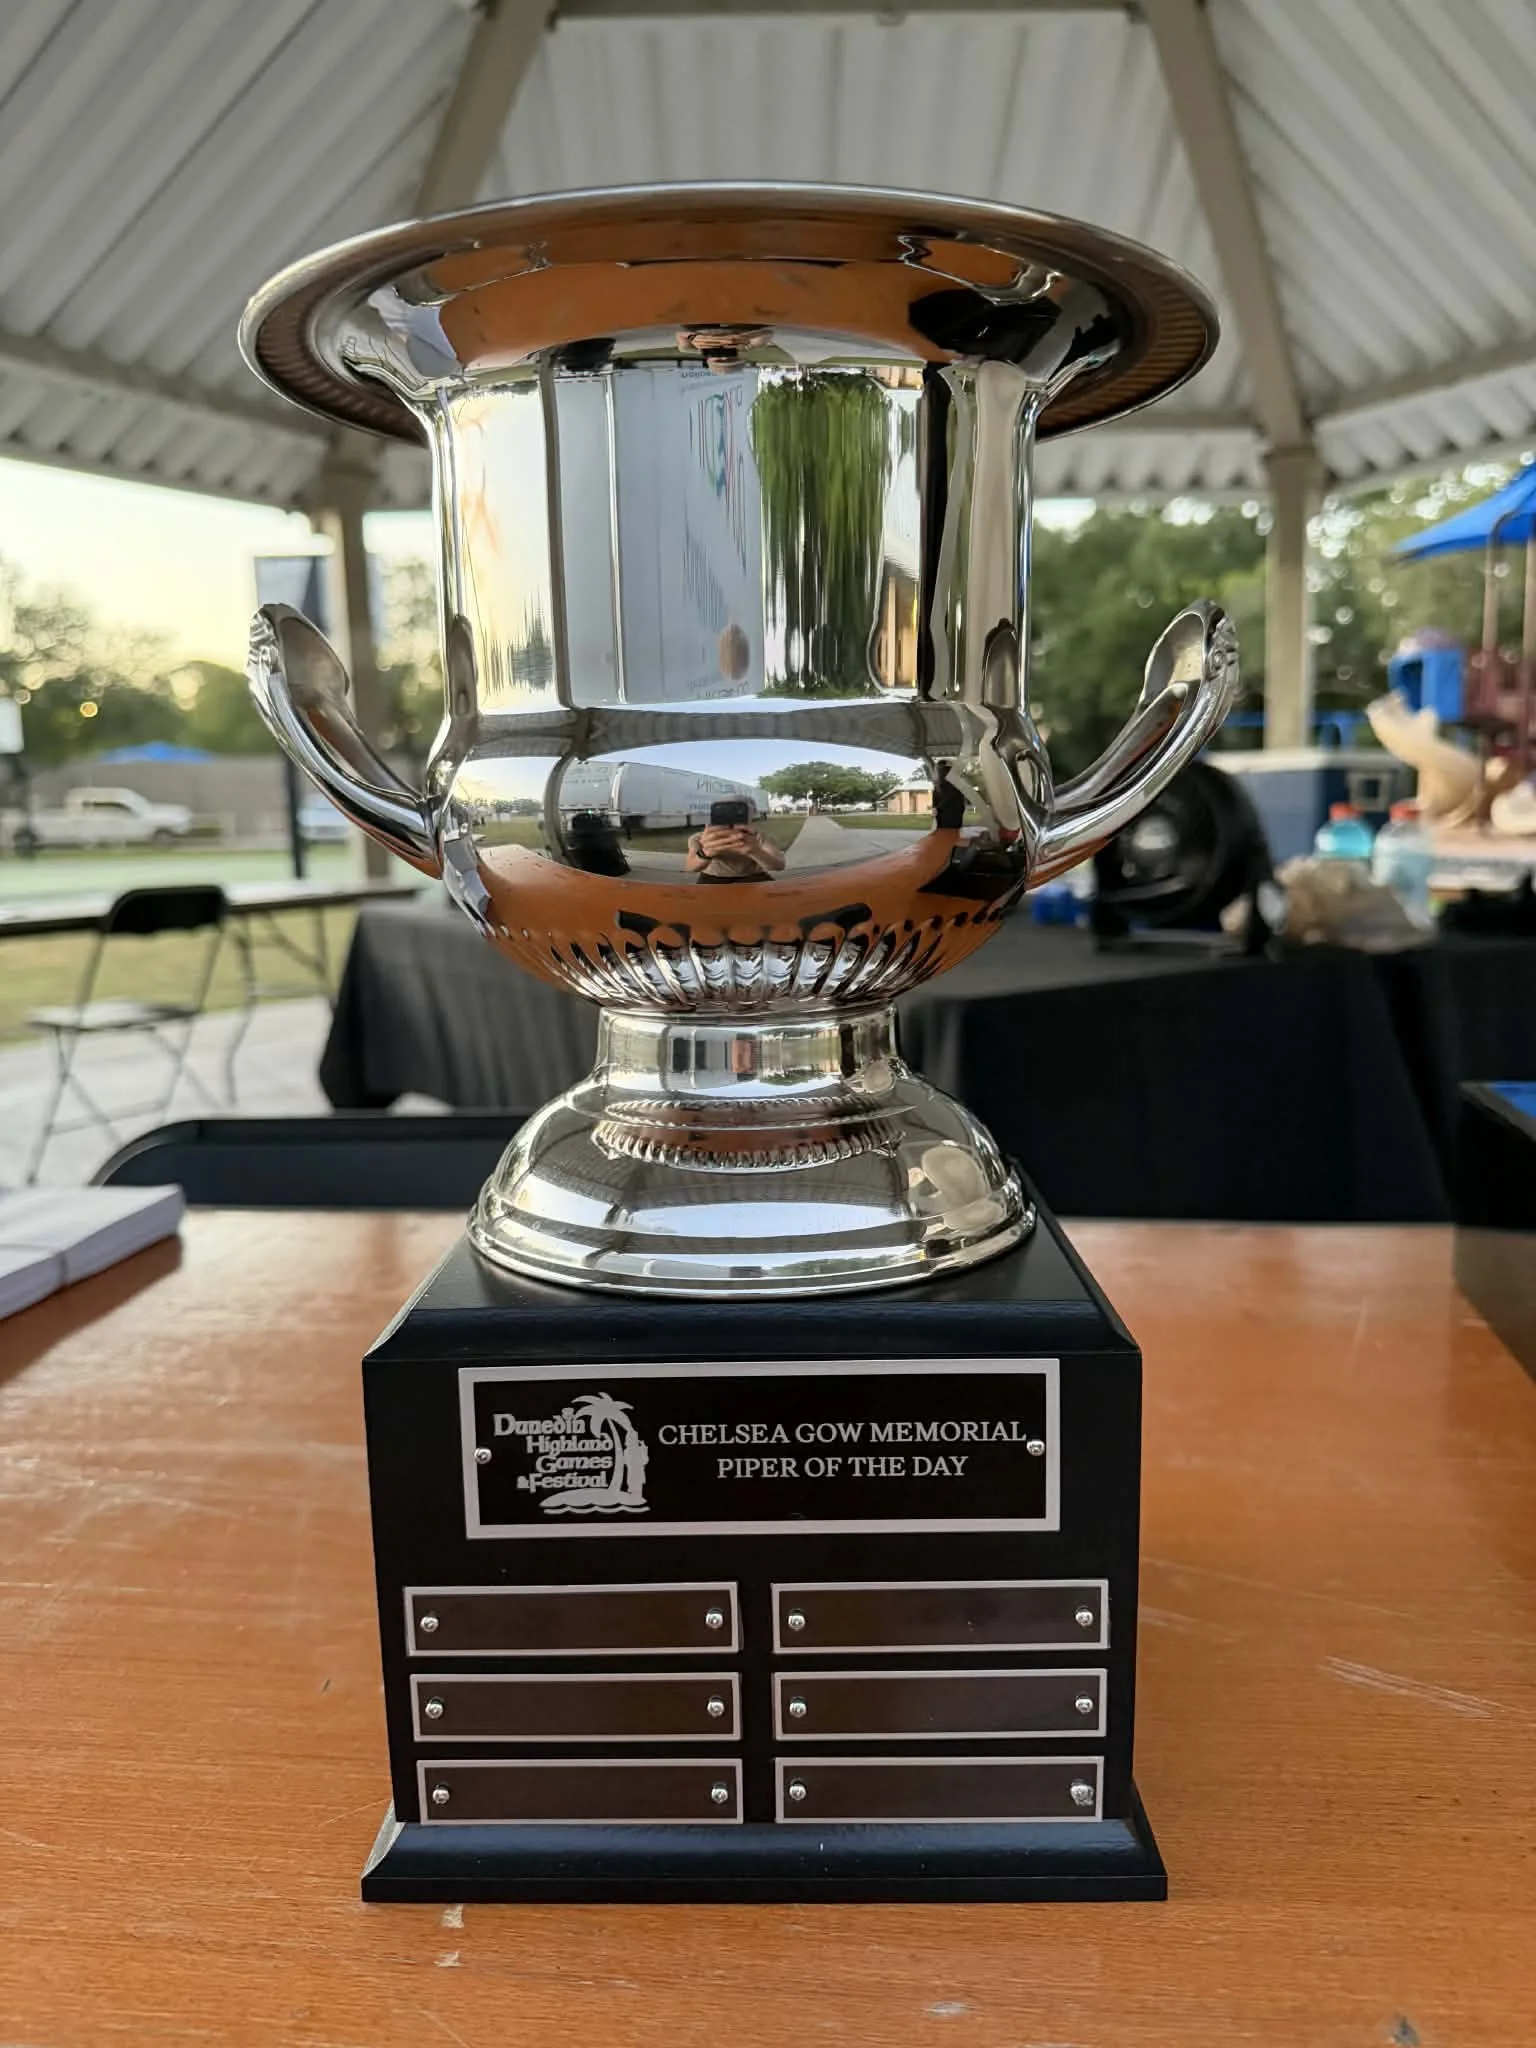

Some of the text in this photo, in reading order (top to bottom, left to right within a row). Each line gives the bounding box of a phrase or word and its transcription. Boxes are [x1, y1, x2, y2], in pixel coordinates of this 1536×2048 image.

[493, 1409, 586, 1437] Dunedin
[658, 1421, 1027, 1445] CHELSEA GOW MEMORIAL
[525, 1432, 614, 1456] Highland
[535, 1455, 614, 1474] Games
[717, 1455, 969, 1478] PIPER OF THE DAY
